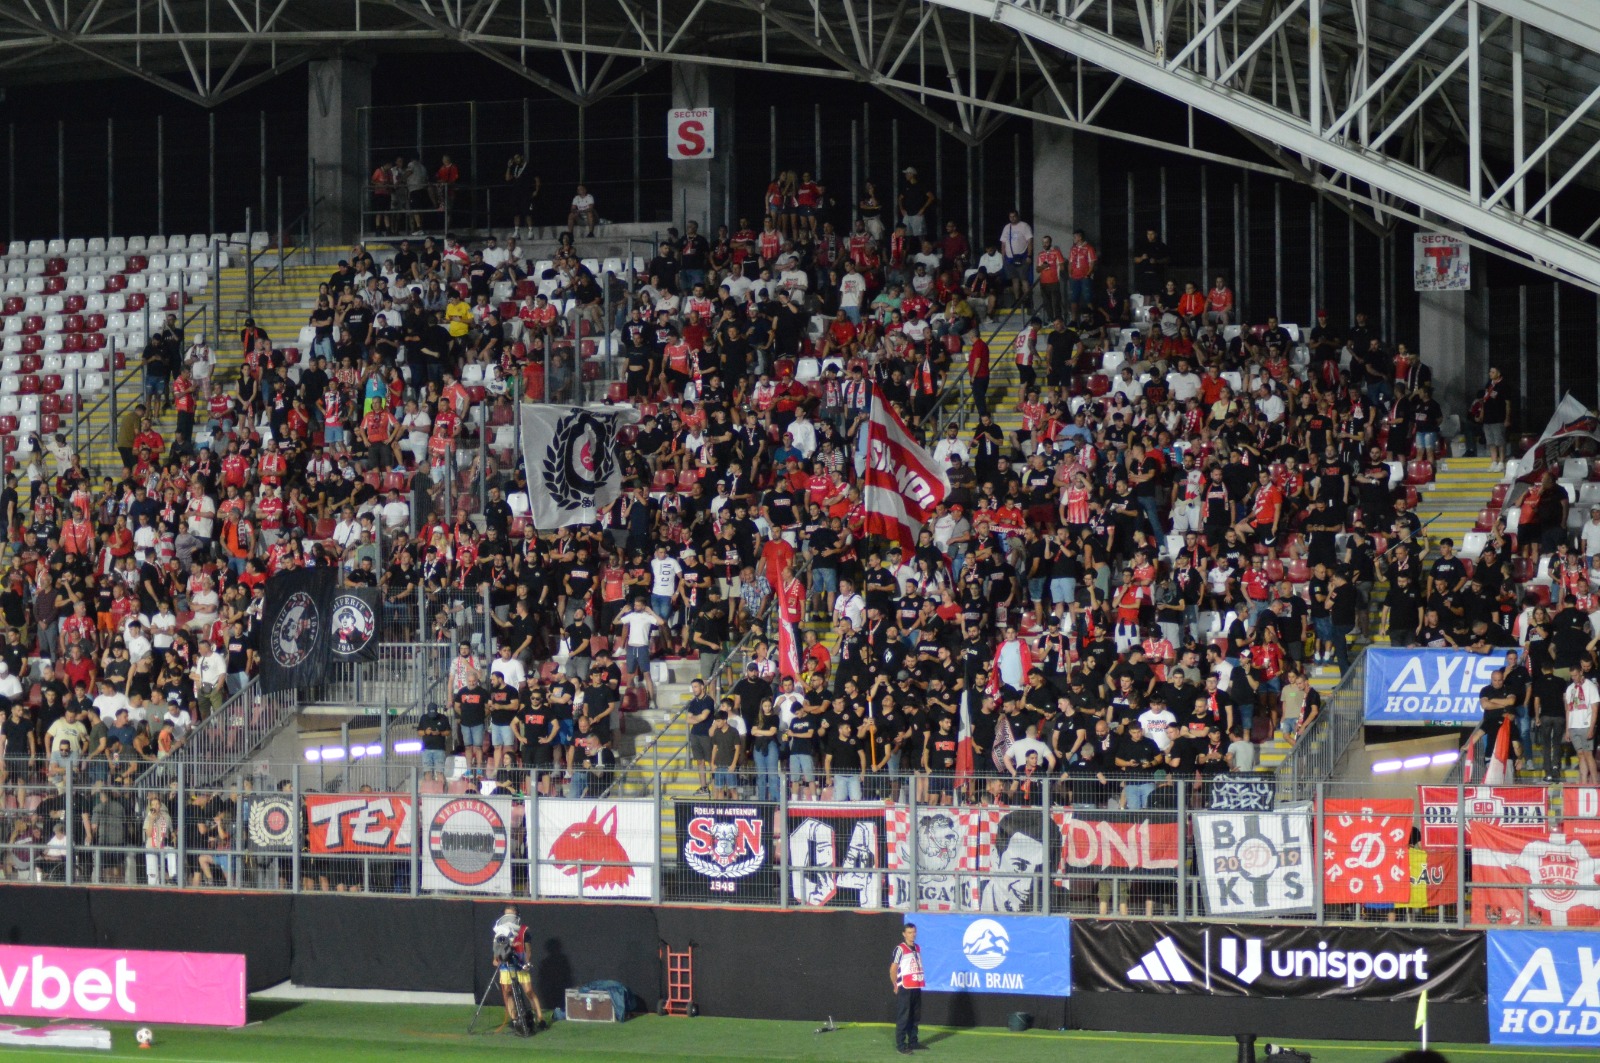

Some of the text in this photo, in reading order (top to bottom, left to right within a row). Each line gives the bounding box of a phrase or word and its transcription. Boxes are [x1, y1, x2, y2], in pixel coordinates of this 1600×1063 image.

[674, 110, 708, 118] SECTOR
[677, 120, 706, 156] S
[1424, 247, 1460, 275] T
[1388, 656, 1506, 694] AXIS
[1384, 696, 1485, 712] HOLDIN
[438, 801, 497, 823] VETERANII
[1067, 818, 1179, 871] DNL
[709, 880, 735, 892] 1948
[1410, 863, 1444, 886] ĂU
[1539, 866, 1579, 880] BANAT
[896, 877, 972, 908] BIGAE
[1271, 941, 1428, 987] unisport
[0, 955, 136, 1014] vbet
[951, 971, 1023, 990] AQUA BRAVA
[1500, 1008, 1600, 1035] HOLD
